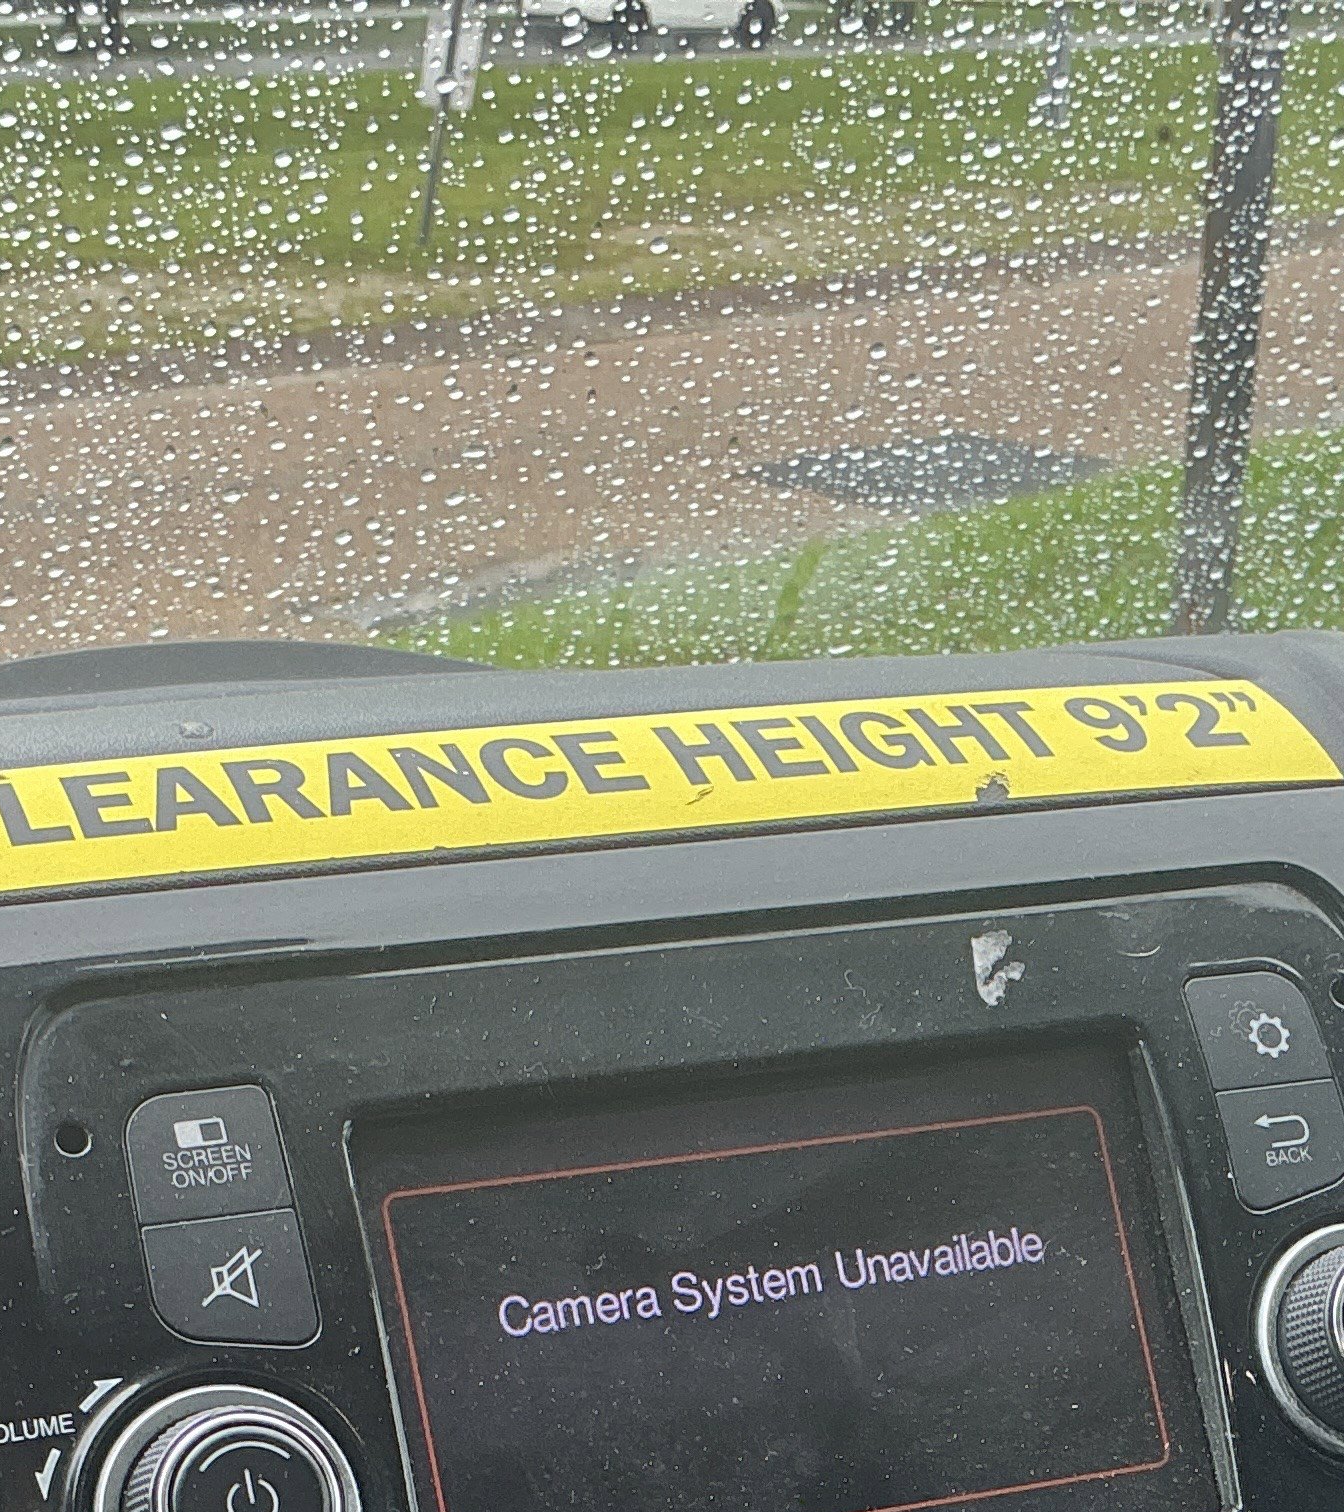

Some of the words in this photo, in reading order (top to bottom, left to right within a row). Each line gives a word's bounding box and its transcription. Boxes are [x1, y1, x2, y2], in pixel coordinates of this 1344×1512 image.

[675, 701, 1056, 789] HEIGHT
[162, 1143, 253, 1172] SCREEN
[1264, 1146, 1314, 1168] BACK
[170, 1162, 254, 1188] ON/OFF
[498, 1281, 663, 1338] Camera
[671, 1260, 824, 1320] System
[833, 1226, 1046, 1290] Unavailable
